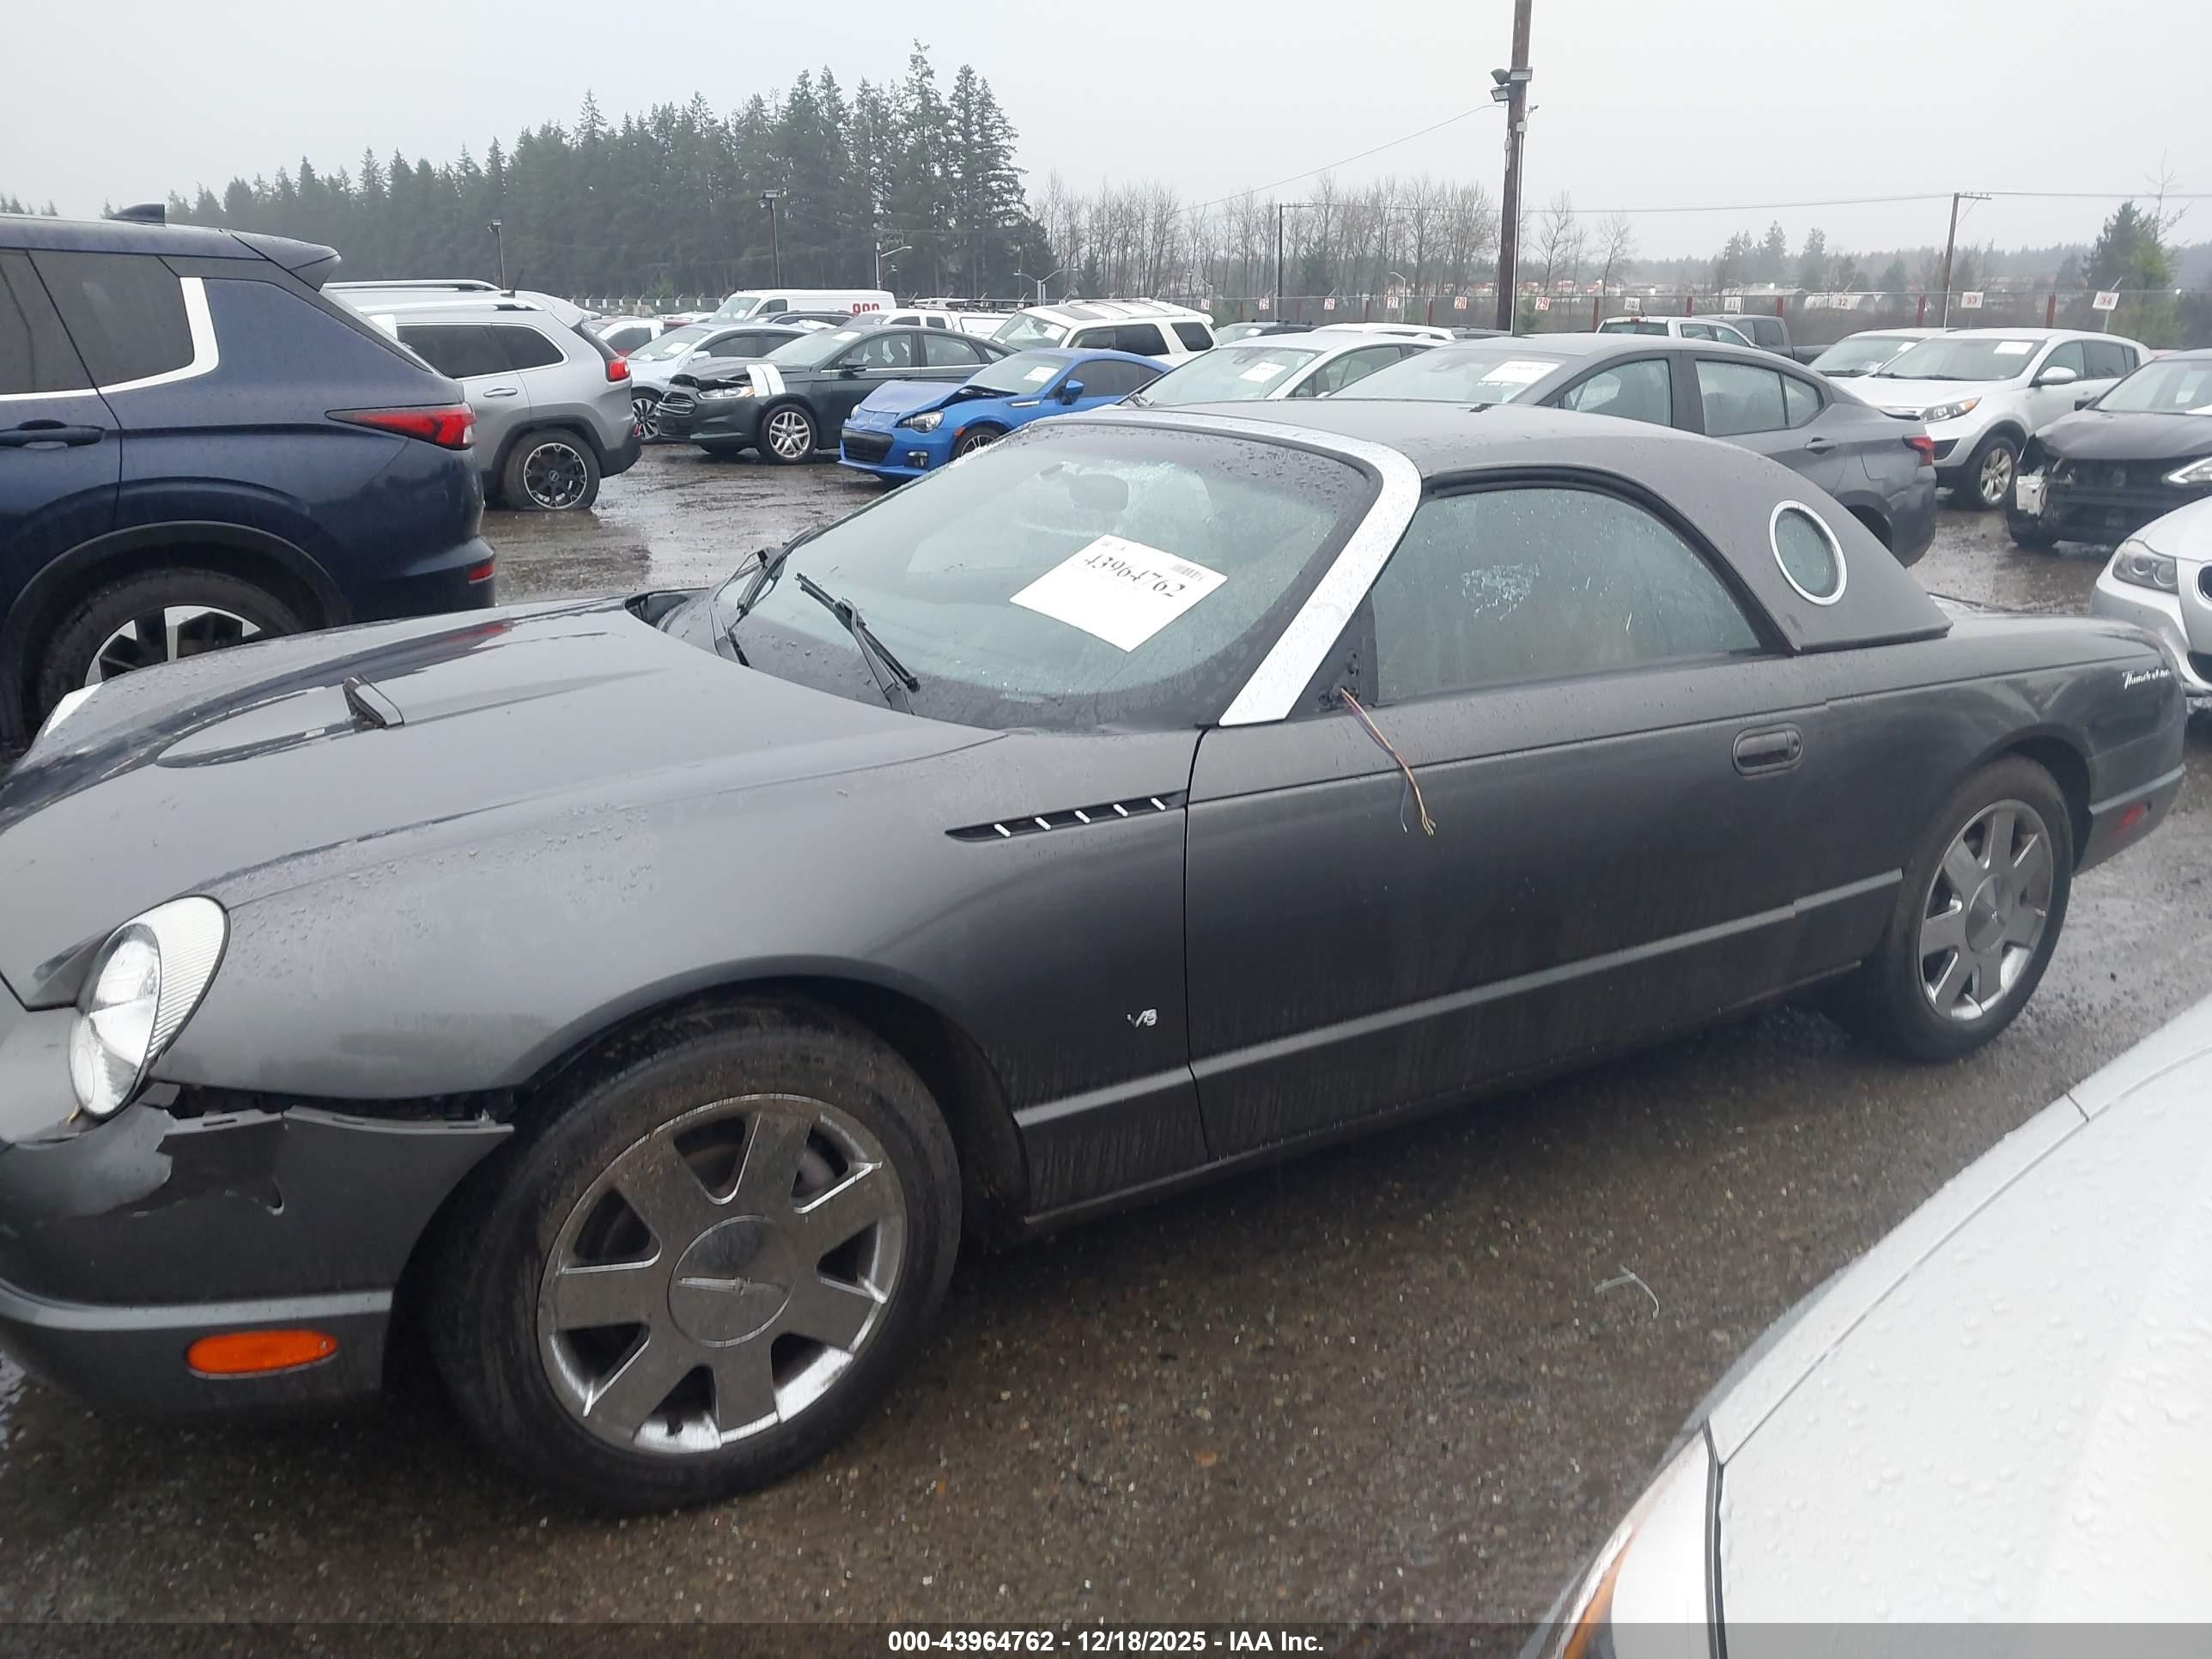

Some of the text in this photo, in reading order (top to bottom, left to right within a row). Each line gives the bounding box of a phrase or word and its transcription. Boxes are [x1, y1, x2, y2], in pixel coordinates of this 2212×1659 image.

[1260, 299, 1268, 309] 25
[1325, 299, 1334, 309] 26
[1389, 297, 1397, 307] 27
[1456, 297, 1466, 308] 28
[1537, 297, 1547, 309] 29
[1085, 554, 1186, 598] 43964762
[1127, 1008, 1157, 1028] V8
